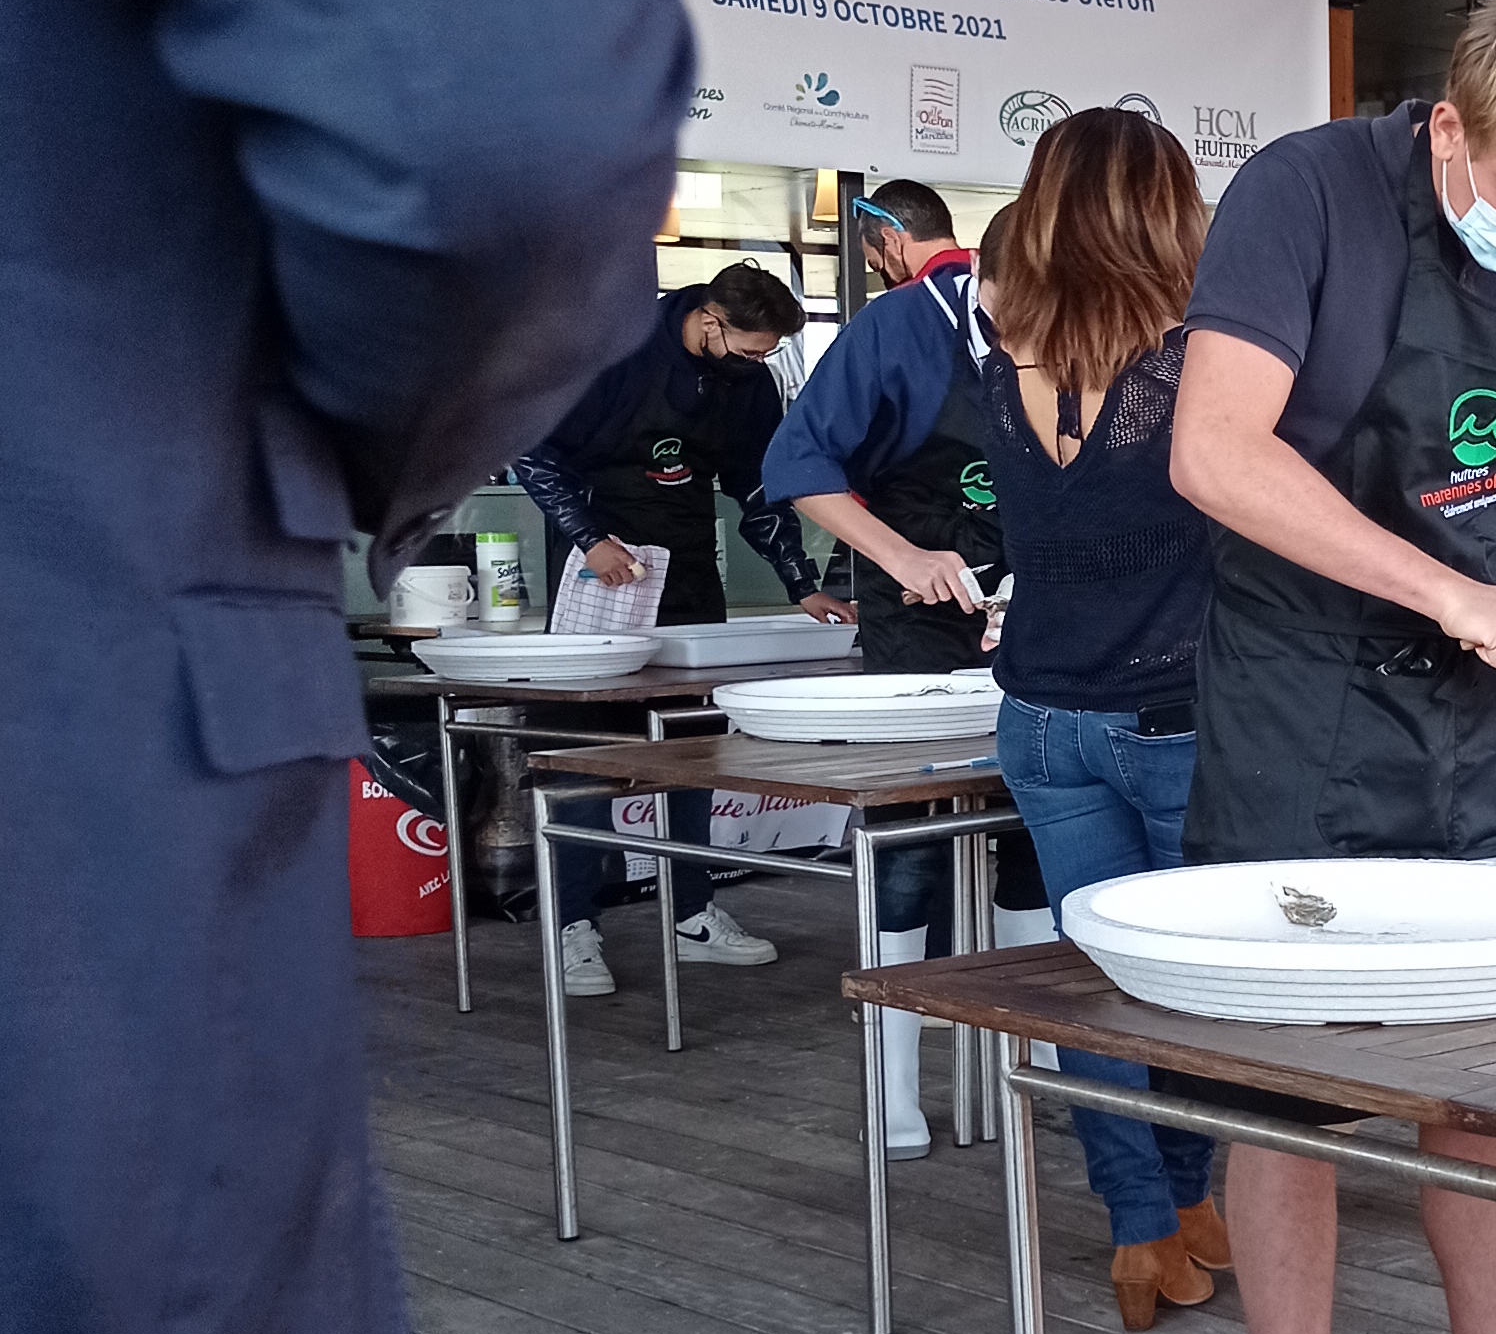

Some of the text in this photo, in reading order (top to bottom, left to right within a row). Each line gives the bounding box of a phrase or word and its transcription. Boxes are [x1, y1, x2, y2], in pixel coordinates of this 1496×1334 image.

[951, 13, 1007, 40] 2021
[1193, 105, 1257, 140] HCM
[1420, 480, 1482, 508] marennes
